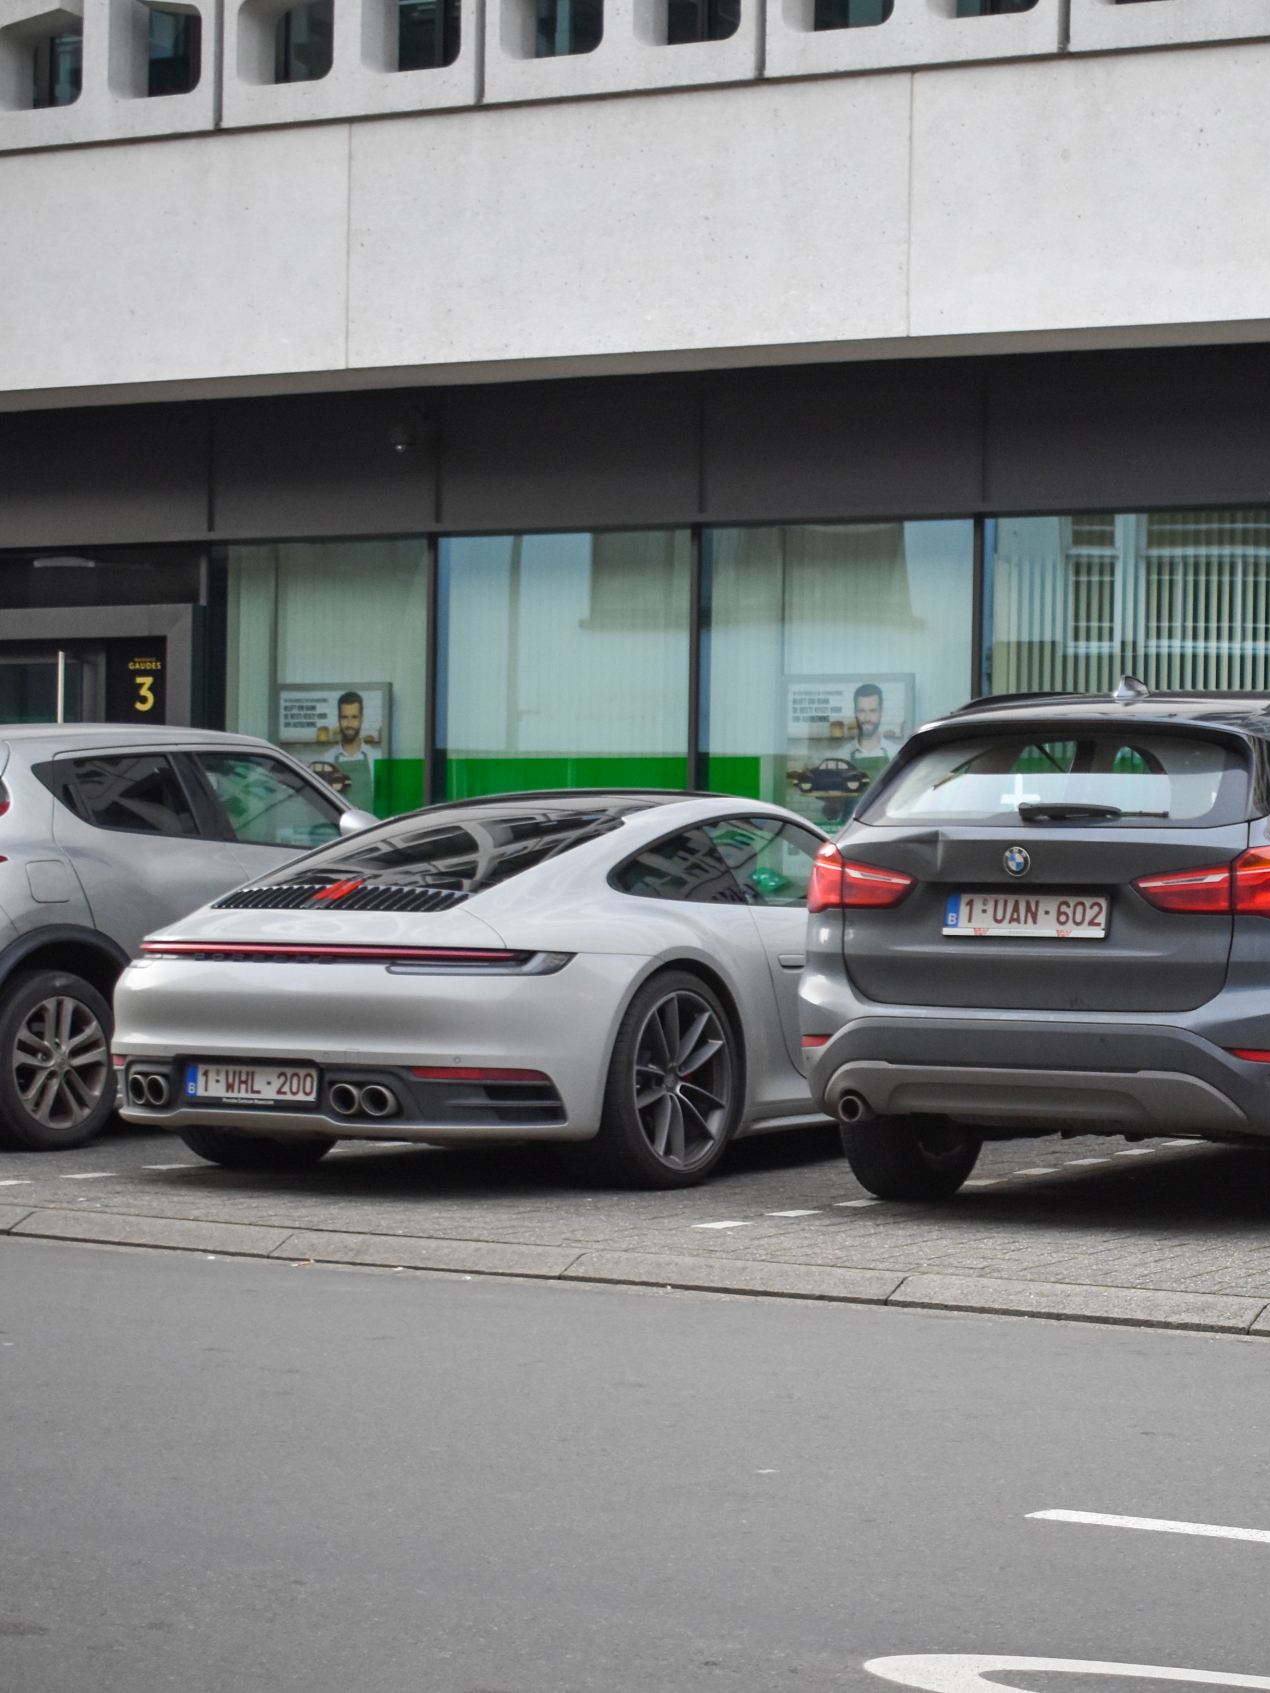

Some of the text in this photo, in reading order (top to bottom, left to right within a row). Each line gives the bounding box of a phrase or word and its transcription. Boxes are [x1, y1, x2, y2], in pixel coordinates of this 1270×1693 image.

[128, 661, 162, 669] GAUDES
[135, 676, 155, 711] 3
[948, 913, 957, 925] B
[194, 952, 336, 964] PORSCHE
[188, 1083, 196, 1094] B
